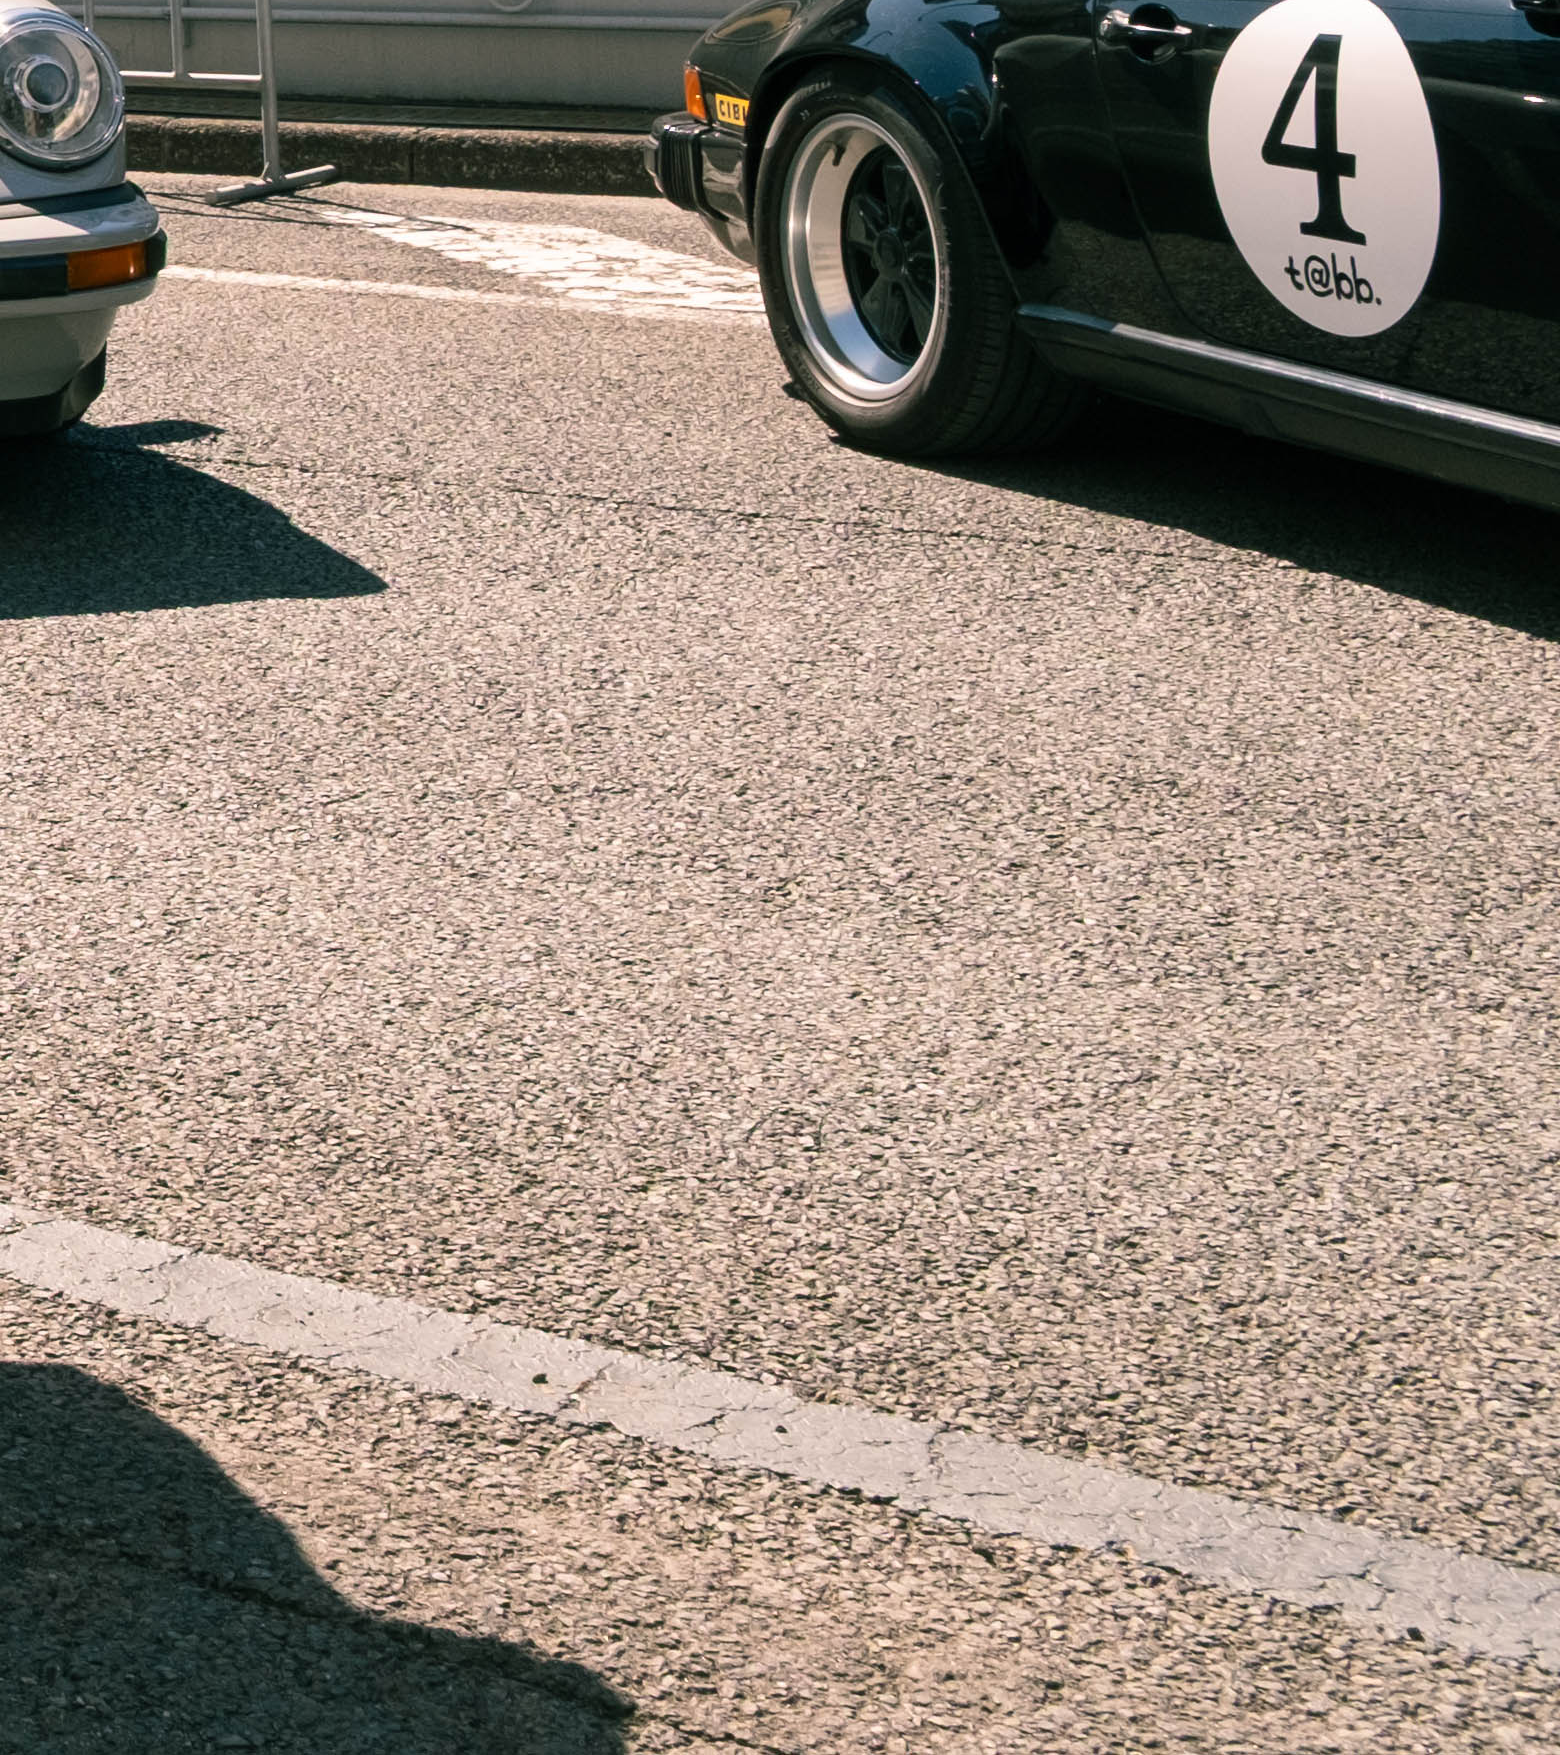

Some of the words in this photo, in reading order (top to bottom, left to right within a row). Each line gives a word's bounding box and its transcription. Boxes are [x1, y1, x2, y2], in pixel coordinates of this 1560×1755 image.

[719, 99, 748, 121] CIBI
[1261, 33, 1367, 245] 4
[1284, 251, 1383, 306] t@bb.
